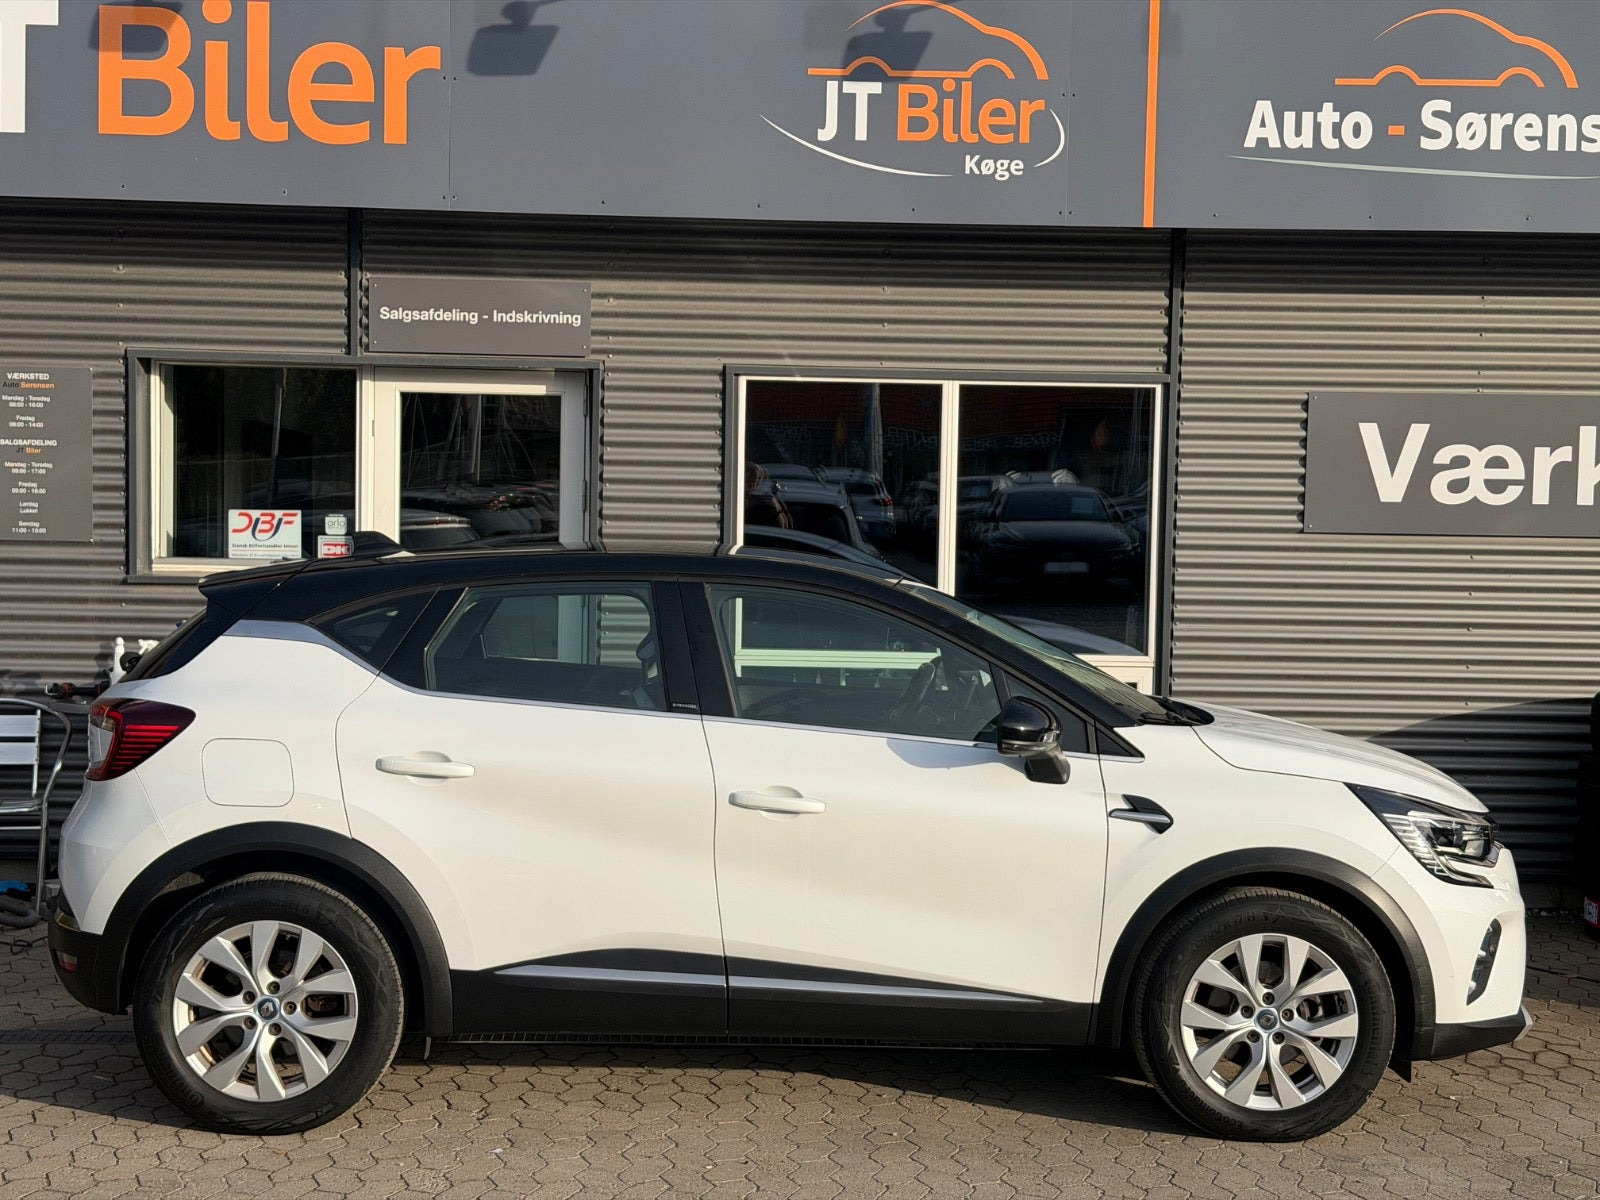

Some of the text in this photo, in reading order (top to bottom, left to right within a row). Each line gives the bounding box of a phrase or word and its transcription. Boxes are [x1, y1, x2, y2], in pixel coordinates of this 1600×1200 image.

[98, 0, 442, 145] Biler
[817, 79, 1046, 145] JT Biler
[1243, 99, 1373, 150] Auto
[1388, 125, 1405, 136] -
[964, 154, 1025, 181] Køge
[379, 306, 479, 325] Salgsafdeling
[493, 309, 582, 327] Indskrivning
[7, 372, 50, 380] VÆRKSTED
